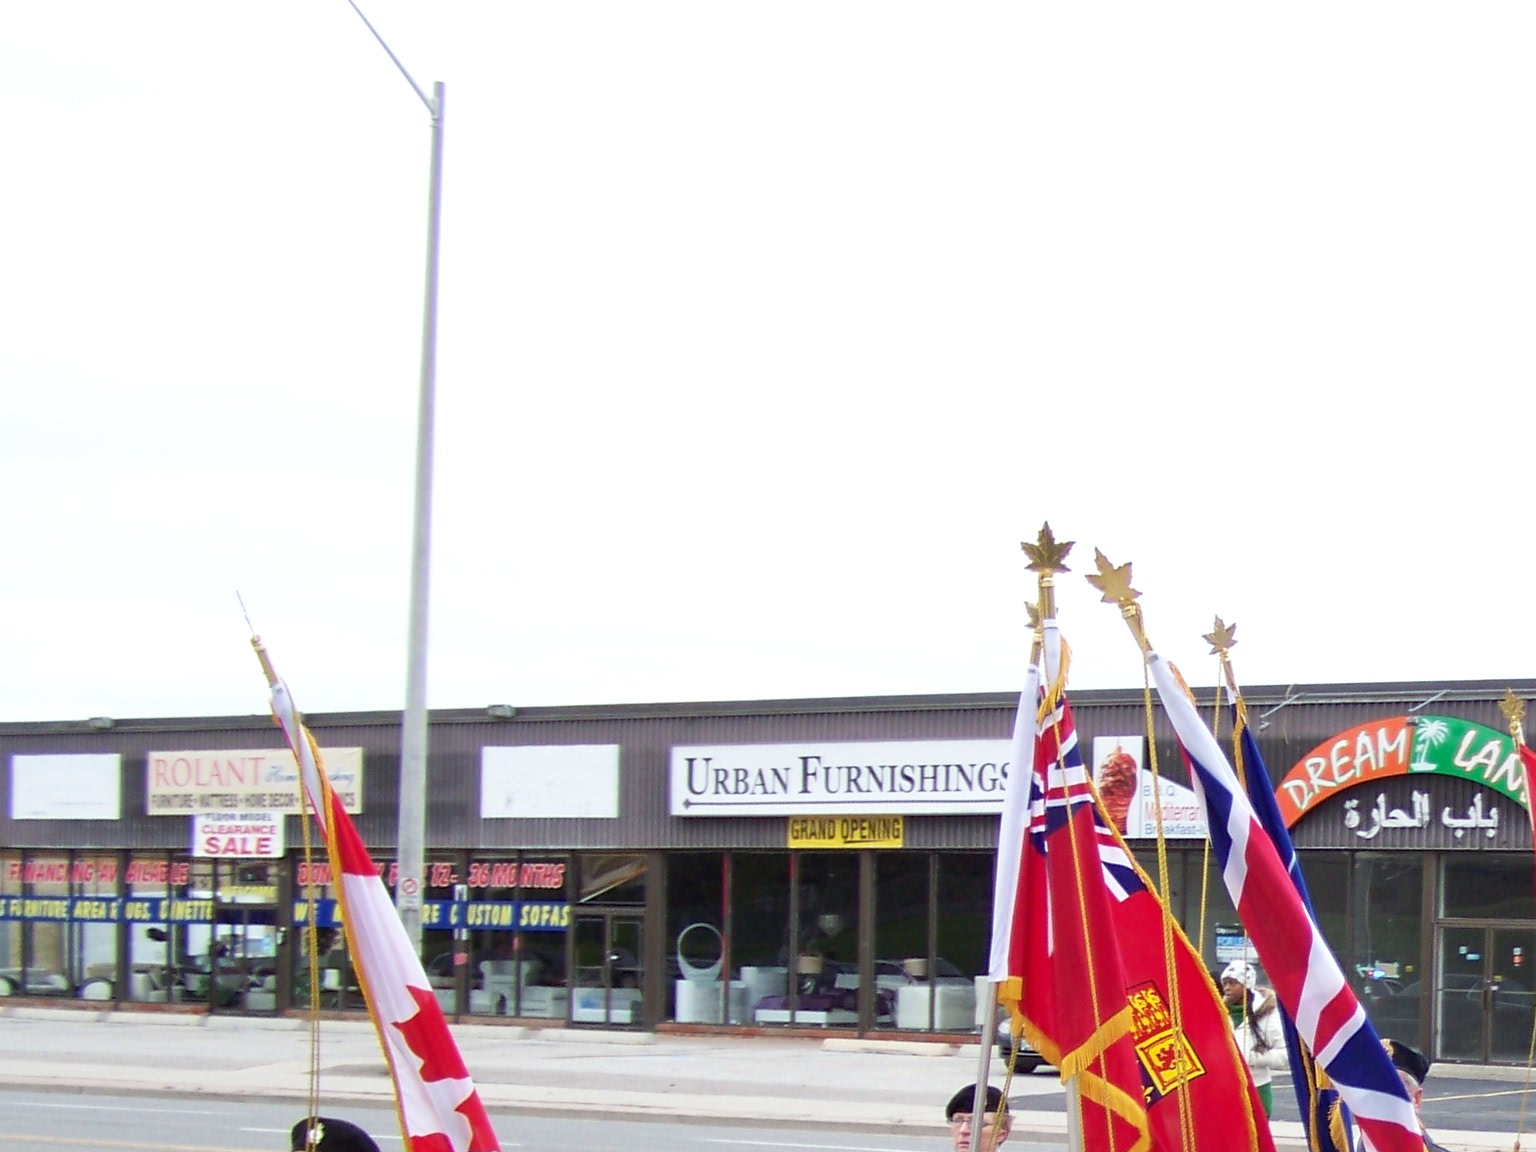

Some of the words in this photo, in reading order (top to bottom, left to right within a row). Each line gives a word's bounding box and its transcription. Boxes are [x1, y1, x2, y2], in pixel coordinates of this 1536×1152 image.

[155, 756, 265, 787] ROLANT
[685, 757, 790, 795] URBAN
[798, 755, 1010, 794] FURNISHINGS
[1283, 726, 1409, 811] DREAM
[1453, 729, 1527, 802] LAN
[1344, 790, 1430, 840] الحارة
[1441, 792, 1499, 839] باب
[202, 824, 276, 835] CLEARANCE
[791, 819, 835, 840] GRAND
[841, 818, 901, 840] OPENING
[205, 836, 272, 855] SALE
[9, 898, 69, 919] FURNITURE
[74, 900, 106, 919] AREA
[450, 903, 513, 926] CUSTOM
[520, 904, 571, 927] SOFAS
